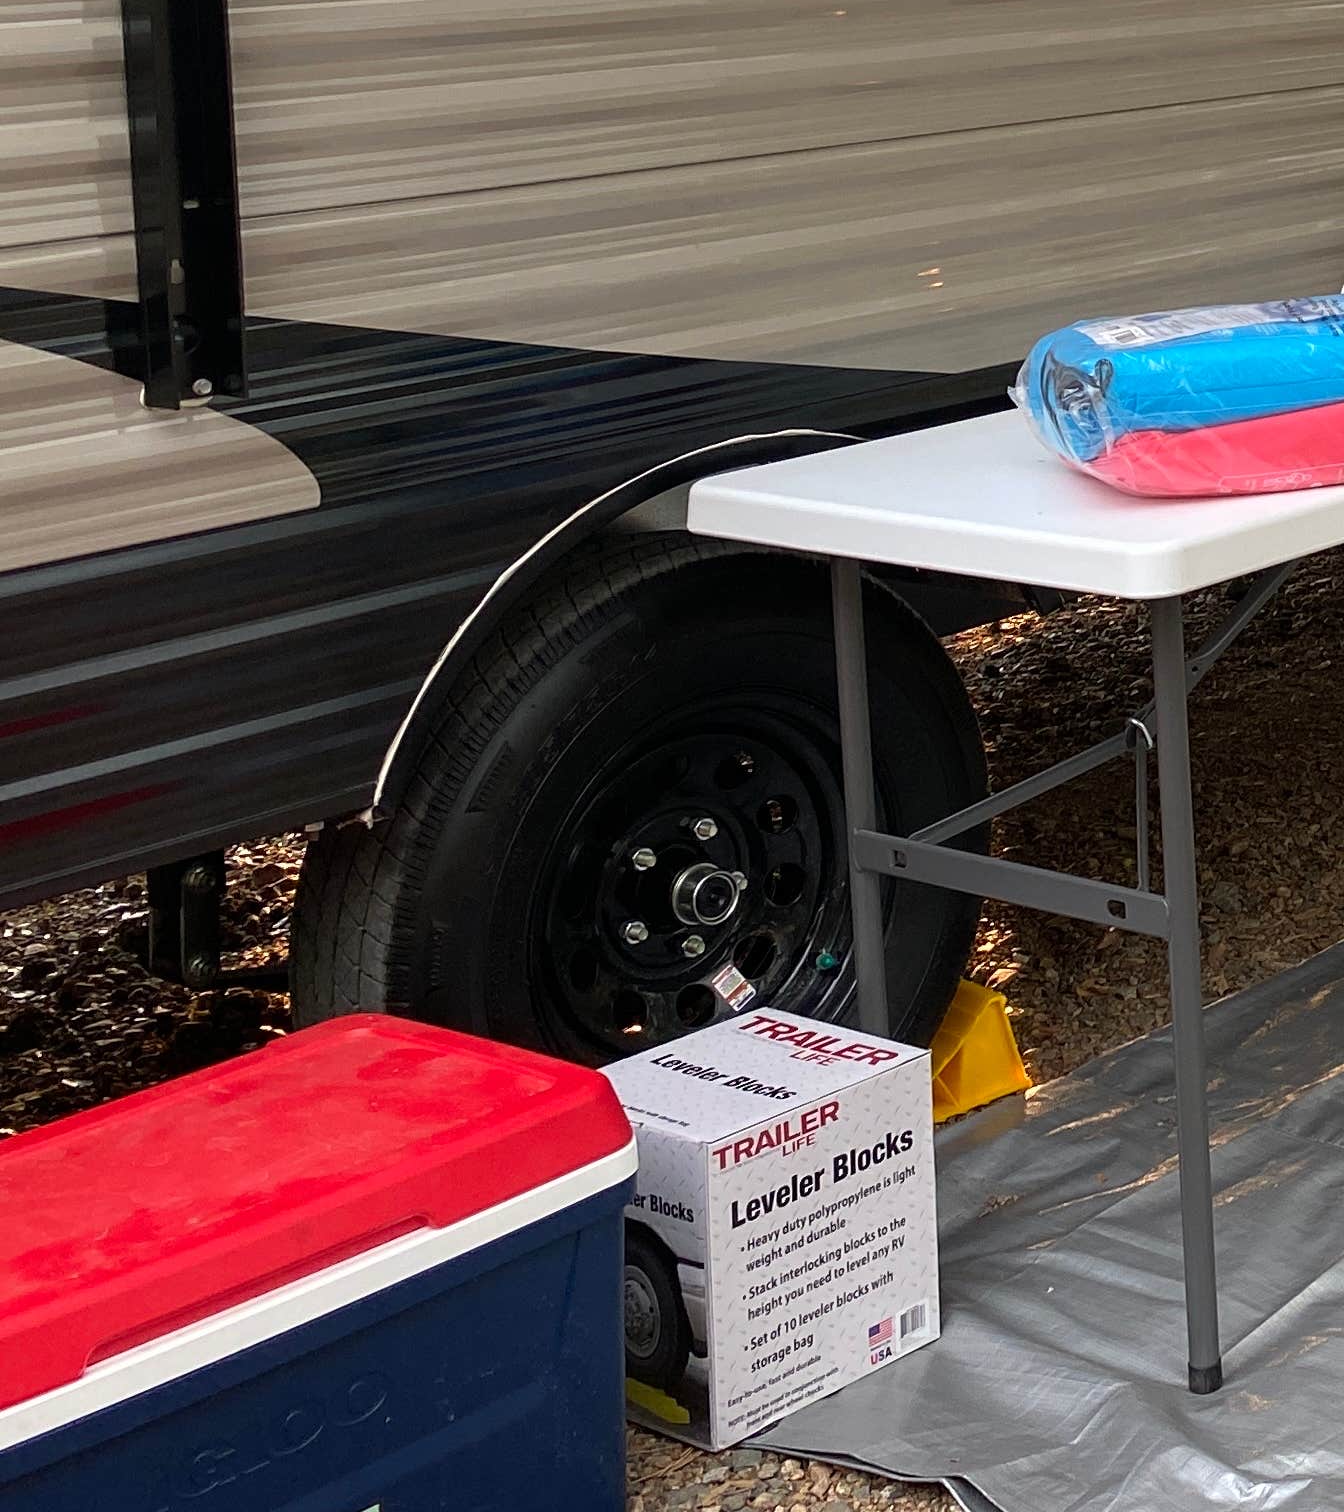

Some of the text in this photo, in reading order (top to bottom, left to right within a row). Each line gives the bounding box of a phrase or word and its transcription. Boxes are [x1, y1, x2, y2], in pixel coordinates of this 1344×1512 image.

[739, 1015, 899, 1066] TRAILER
[789, 1050, 841, 1067] LIFE
[650, 1054, 797, 1102] Leveler Blocks
[713, 1101, 839, 1169] TRAILER
[783, 1133, 815, 1157] LIFE
[732, 1130, 913, 1229] Leveler Blocks
[650, 1194, 694, 1223] Blocks
[748, 1165, 915, 1251] Heavy duty polypropylene is light
[746, 1218, 845, 1271] weight and durable
[749, 1218, 905, 1299] Stack interlocking blocks to the
[748, 1235, 904, 1320] height you need to level any RV
[751, 1271, 893, 1350] Set of 10 leveler blocks with
[752, 1334, 813, 1373] storage bag
[871, 1347, 892, 1365] USA
